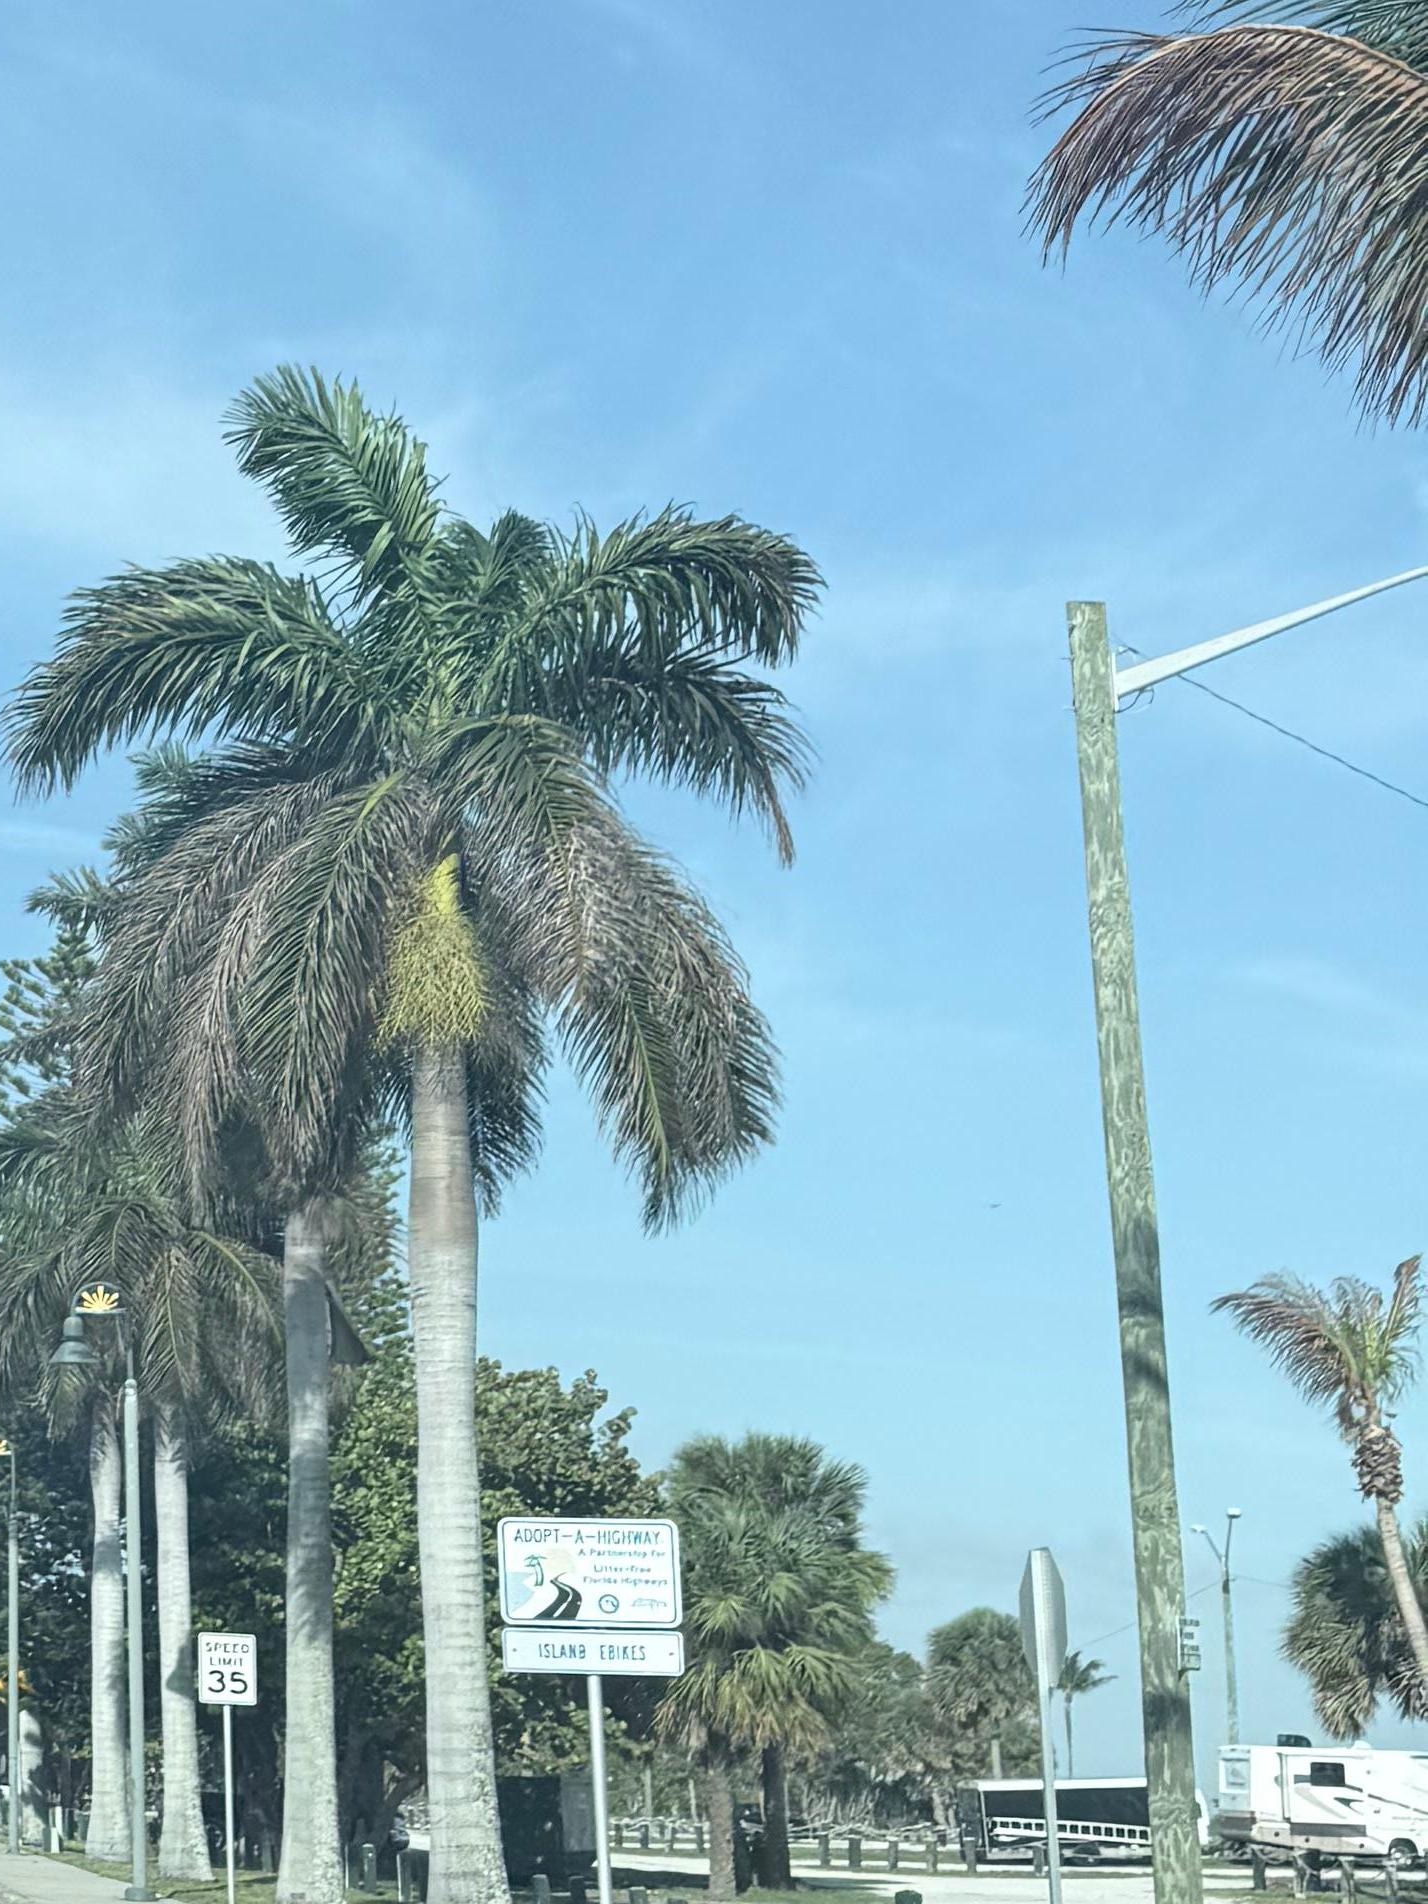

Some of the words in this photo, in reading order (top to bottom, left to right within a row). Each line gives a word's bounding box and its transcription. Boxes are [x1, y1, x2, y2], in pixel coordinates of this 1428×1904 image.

[205, 1641, 250, 1654] SPEED
[538, 1643, 586, 1659] ISLAND
[599, 1644, 646, 1661] EBIKES
[209, 1656, 244, 1667] LIMIT
[207, 1669, 249, 1695] 35
